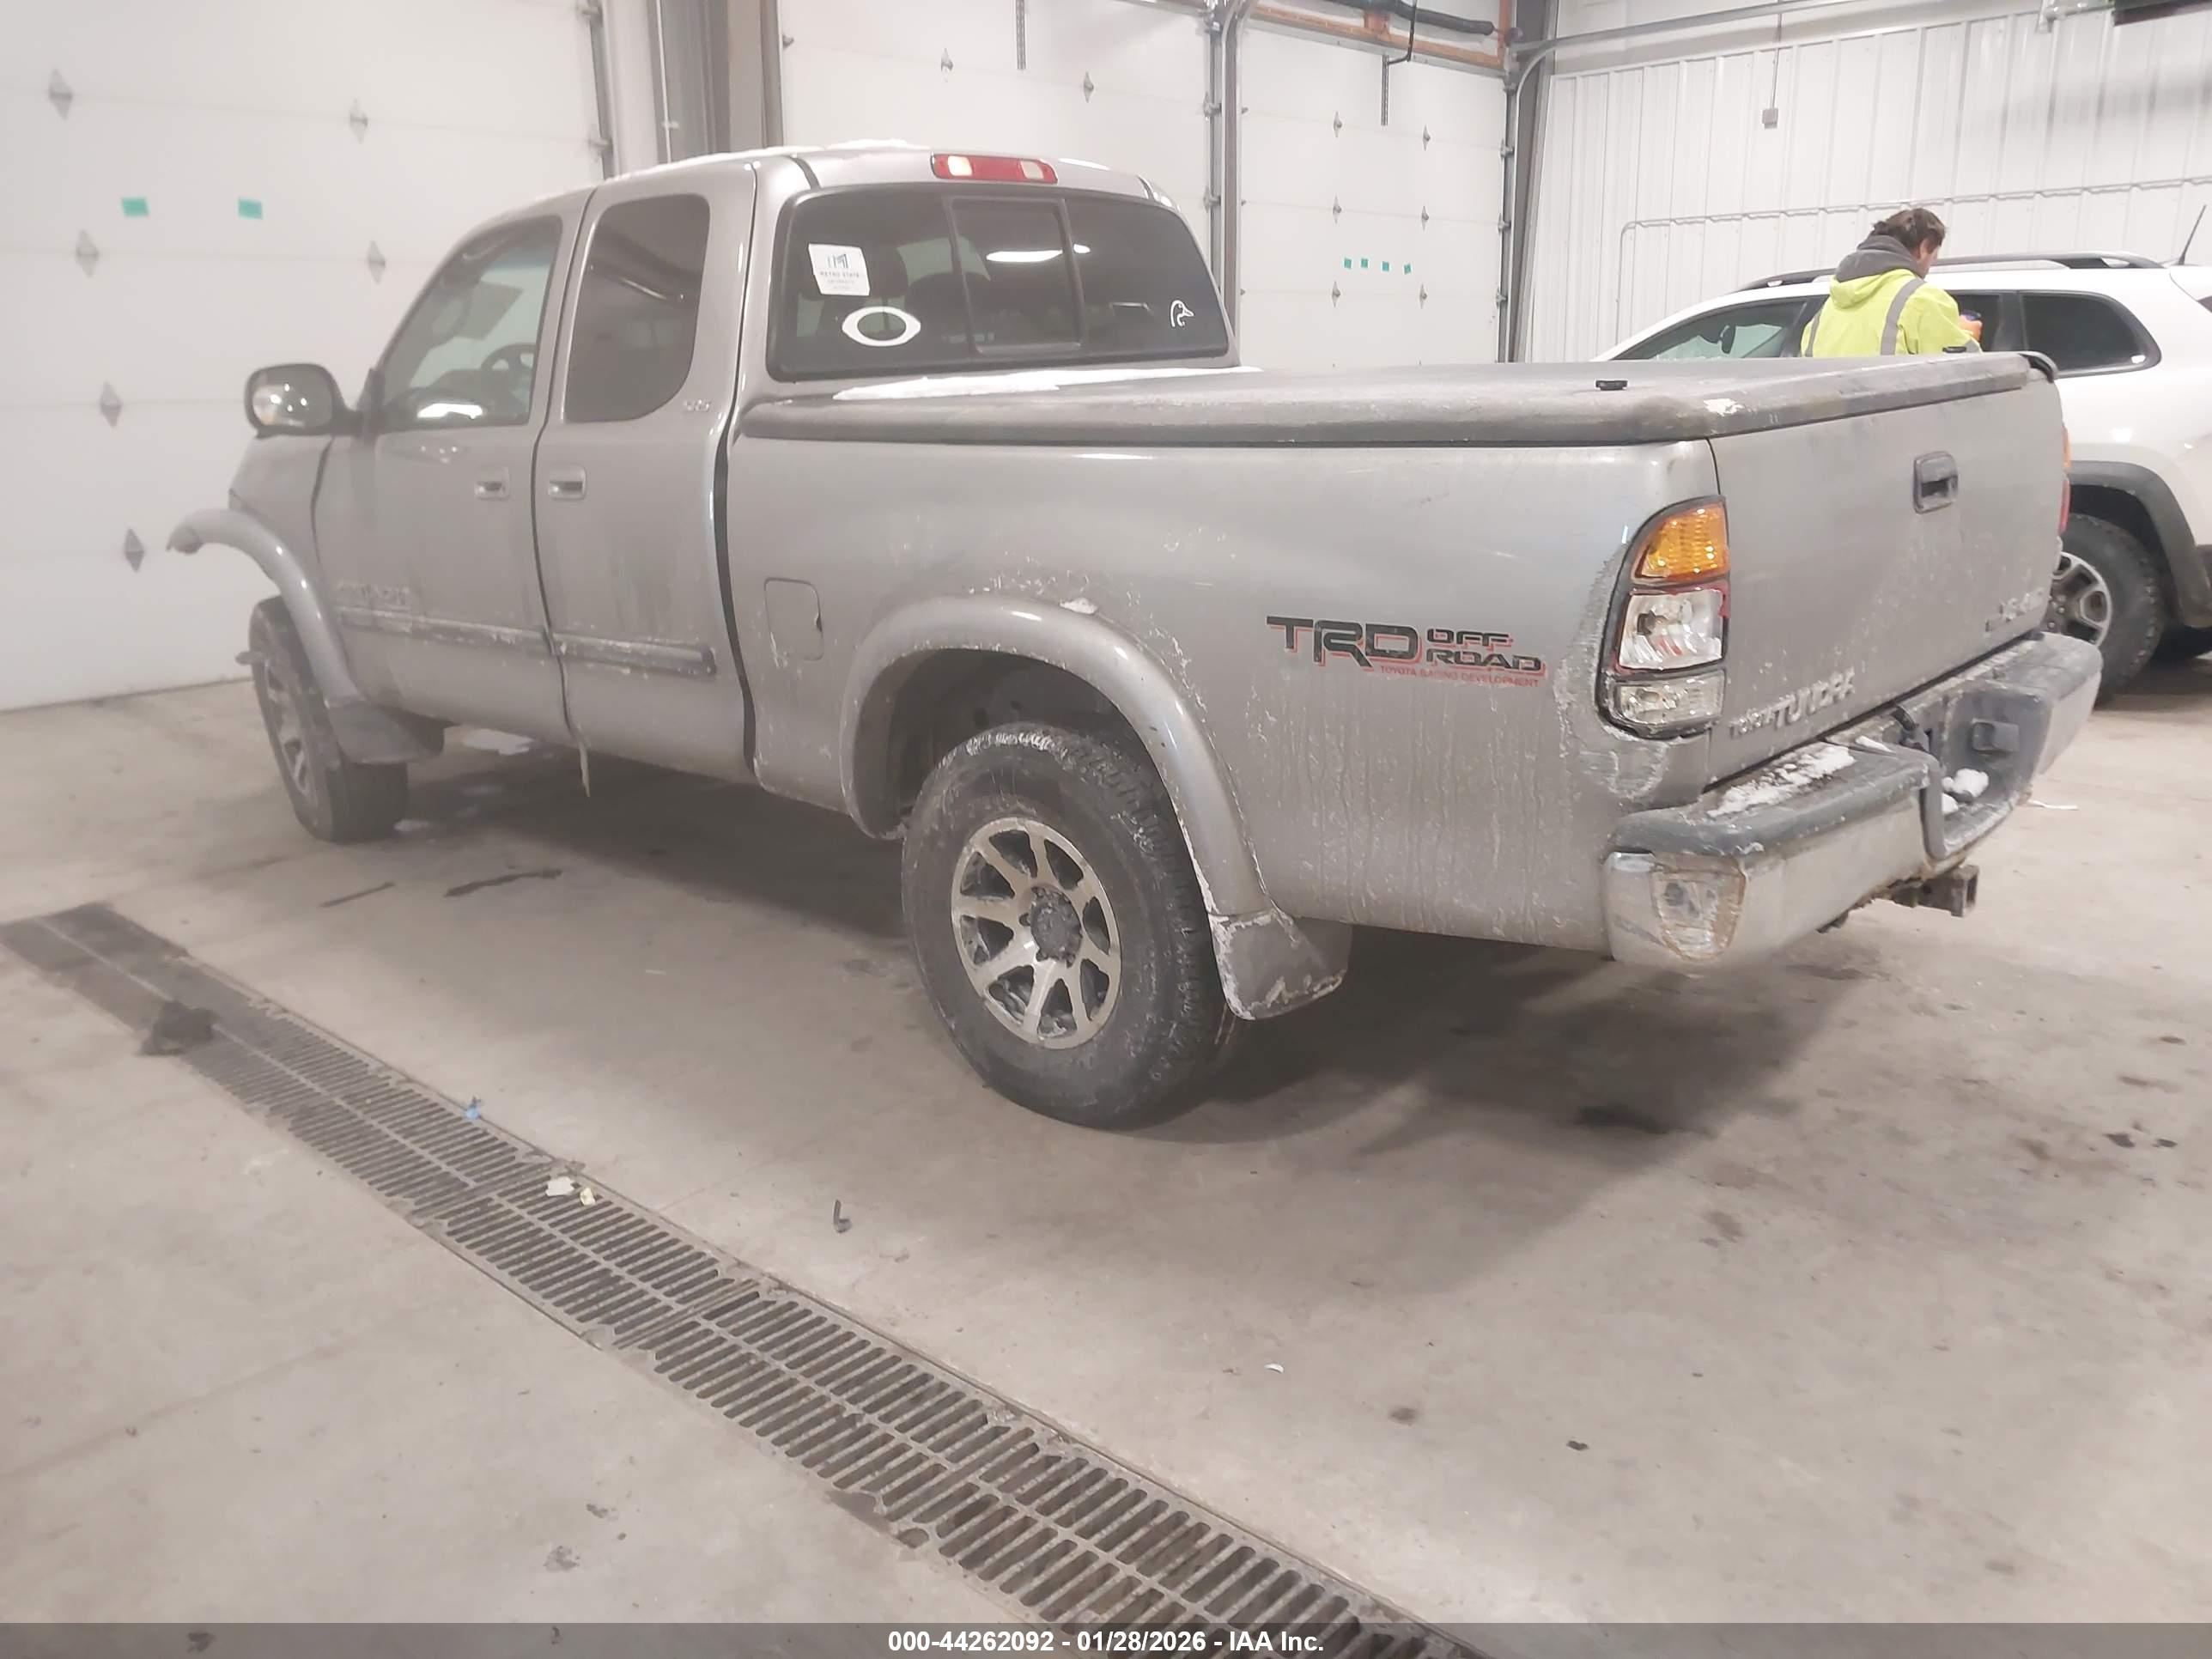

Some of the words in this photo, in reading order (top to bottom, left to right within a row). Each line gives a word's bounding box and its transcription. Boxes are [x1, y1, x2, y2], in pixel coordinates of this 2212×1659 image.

[1267, 616, 1422, 670] TRD
[1426, 628, 1513, 648] OFF
[1426, 648, 1546, 676] ROAD
[1381, 665, 1417, 678] TOYOTA
[1419, 669, 1458, 681] RACING
[1461, 672, 1539, 687] DEVELOPMENT
